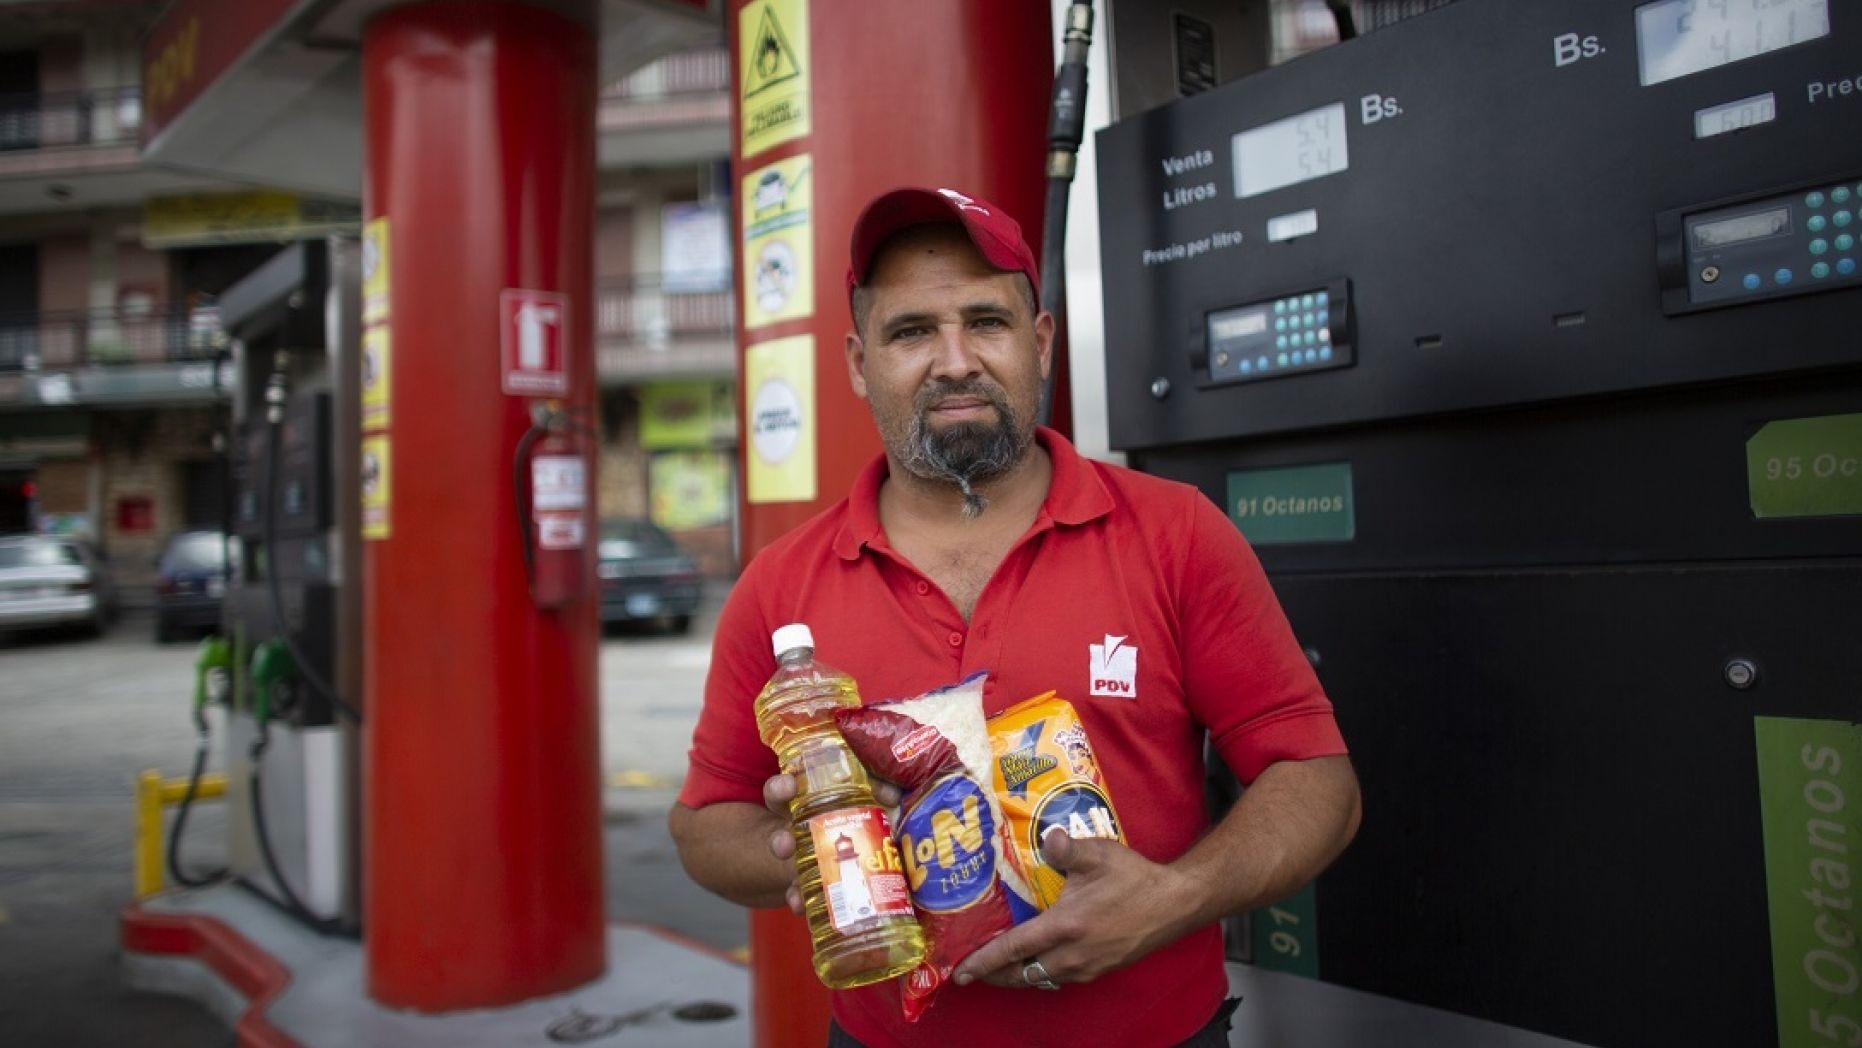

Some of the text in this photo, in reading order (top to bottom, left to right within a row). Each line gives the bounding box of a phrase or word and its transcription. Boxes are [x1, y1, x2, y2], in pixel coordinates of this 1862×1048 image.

[1553, 32, 1607, 68] Bs.
[1361, 93, 1404, 125] Bs.
[1162, 149, 1214, 176] Venta
[1163, 181, 1217, 209] Litros
[1143, 230, 1243, 265] Precio por litro
[1765, 456, 1802, 481] 95
[1237, 495, 1344, 517] 91 Octanos
[1094, 679, 1130, 693] PDV
[1041, 807, 1120, 839] AN
[1801, 744, 1861, 995] Octanos
[1268, 905, 1301, 959] 91
